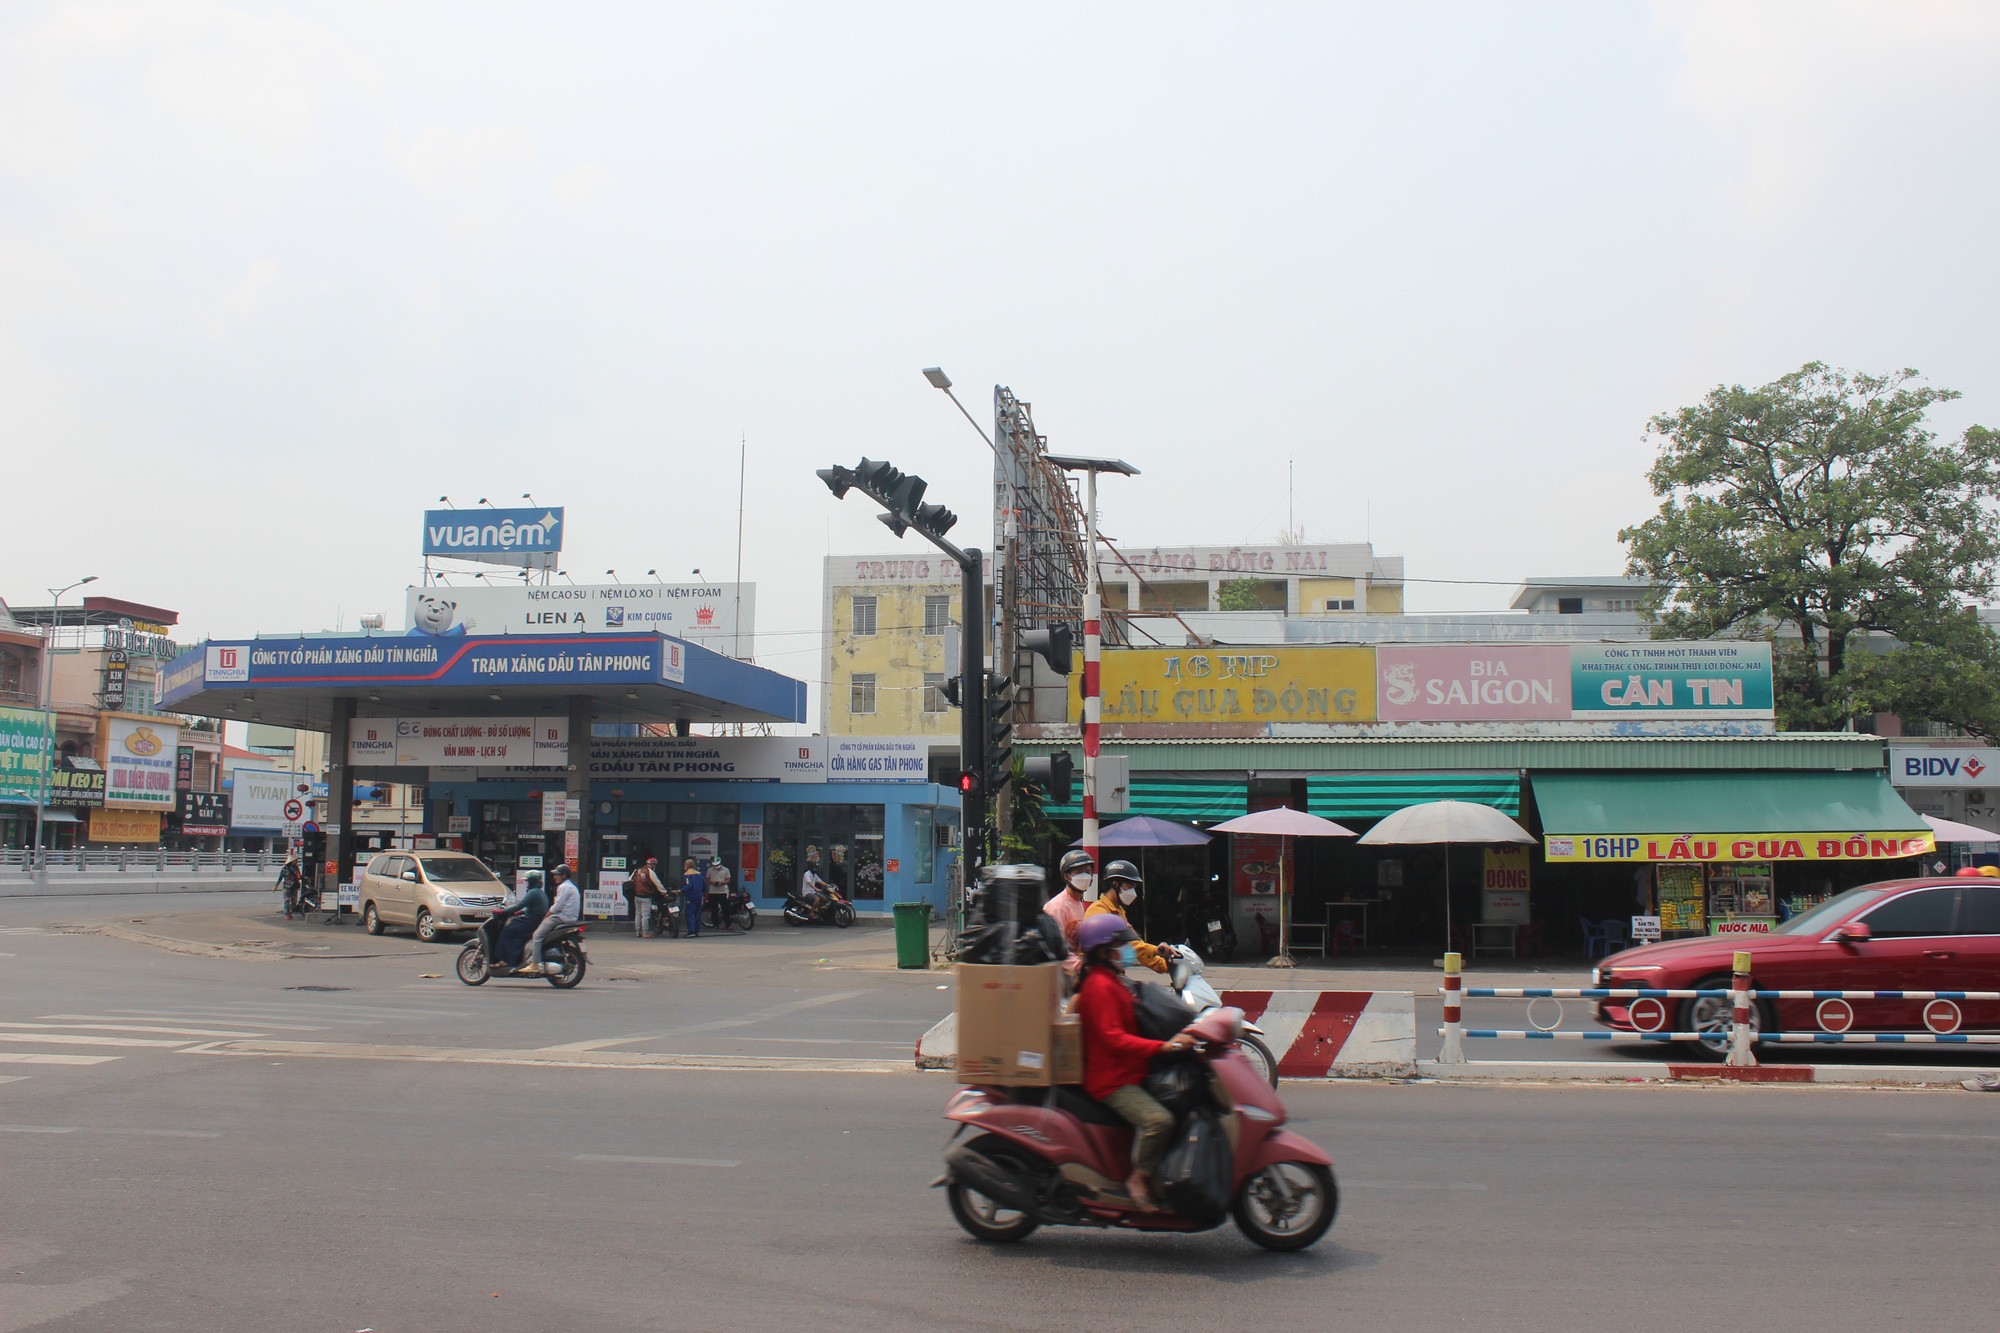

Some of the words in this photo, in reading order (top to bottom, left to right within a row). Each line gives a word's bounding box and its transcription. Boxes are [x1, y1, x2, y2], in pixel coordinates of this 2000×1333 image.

[1210, 547, 1273, 571] ĐỒNG
[1286, 552, 1327, 570] NAI
[856, 560, 930, 579] TRUNG
[528, 590, 550, 601] NỆM
[552, 590, 572, 599] CAO
[574, 590, 587, 599] SU
[600, 588, 622, 601] NỆM
[624, 588, 637, 598] LÒ
[639, 590, 654, 598] XO
[667, 587, 690, 600] NỆM
[692, 589, 722, 598] FOAM
[627, 613, 642, 621] KIM
[252, 648, 276, 665] CÔNG
[278, 651, 290, 664] TY
[291, 644, 303, 664] CỔ
[306, 645, 332, 664] PHẦN
[335, 646, 362, 664] XĂNG
[364, 644, 384, 663] DẦU
[386, 645, 404, 663] TÍN
[405, 644, 438, 663] NGHĨA
[1605, 649, 1629, 658] CÔNG
[1643, 649, 1665, 657] TNHH
[472, 658, 508, 676] TRẠM
[511, 654, 545, 672] XĂNG
[549, 651, 574, 672] DẦU
[577, 653, 603, 672] TÂN
[604, 655, 650, 671] PHONG
[1470, 661, 1509, 676] BIA
[1582, 663, 1602, 671] KHAI
[1747, 662, 1762, 670] NAI
[110, 671, 122, 680] KIM
[208, 669, 247, 677] TINNGHIA
[108, 681, 123, 691] BÍCH
[1426, 679, 1553, 705] SAIGON
[1601, 675, 1674, 706] CĂN
[1686, 679, 1743, 706] TIN
[1174, 687, 1242, 715] CUA
[423, 726, 442, 738] ĐÚNG
[443, 725, 459, 737] CHẤT
[460, 726, 482, 739] LƯỢNG
[488, 725, 498, 737] ĐỦ
[499, 723, 508, 737] SỐ
[509, 726, 531, 739] LƯỢNG
[26, 736, 38, 750] CAO
[40, 738, 52, 750] CP
[352, 741, 394, 749] TINNGHIA
[840, 743, 851, 751] CÔNG
[444, 744, 456, 757] VĂN
[458, 747, 475, 756] MINH
[481, 746, 495, 758] LỊCH
[497, 745, 507, 757] SỰ
[613, 750, 640, 759] XĂNG
[666, 750, 684, 759] TÍN
[686, 749, 720, 759] NGHĨA
[602, 760, 634, 772] DẦU
[638, 761, 670, 772] TÂN
[674, 762, 735, 772] PHONG
[831, 754, 845, 771] CỬA
[847, 756, 867, 771] HÀNG
[868, 758, 882, 771] GAS
[884, 756, 898, 771] TÂN
[899, 758, 924, 771] PHONG
[1905, 758, 1960, 776] BIDV
[71, 772, 90, 788] KEO
[92, 774, 105, 789] XE
[250, 786, 288, 800] VIVIAN
[92, 822, 108, 836] KIM
[1582, 837, 1640, 859] 16HP
[1648, 834, 1718, 860] LẨU
[1731, 839, 1806, 860] CUA
[1817, 832, 1927, 858] ĐỒNG
[1486, 862, 1527, 888] ĐỒNG
[1718, 922, 1747, 933] NƯỚC
[1749, 921, 1769, 933] MÍA
